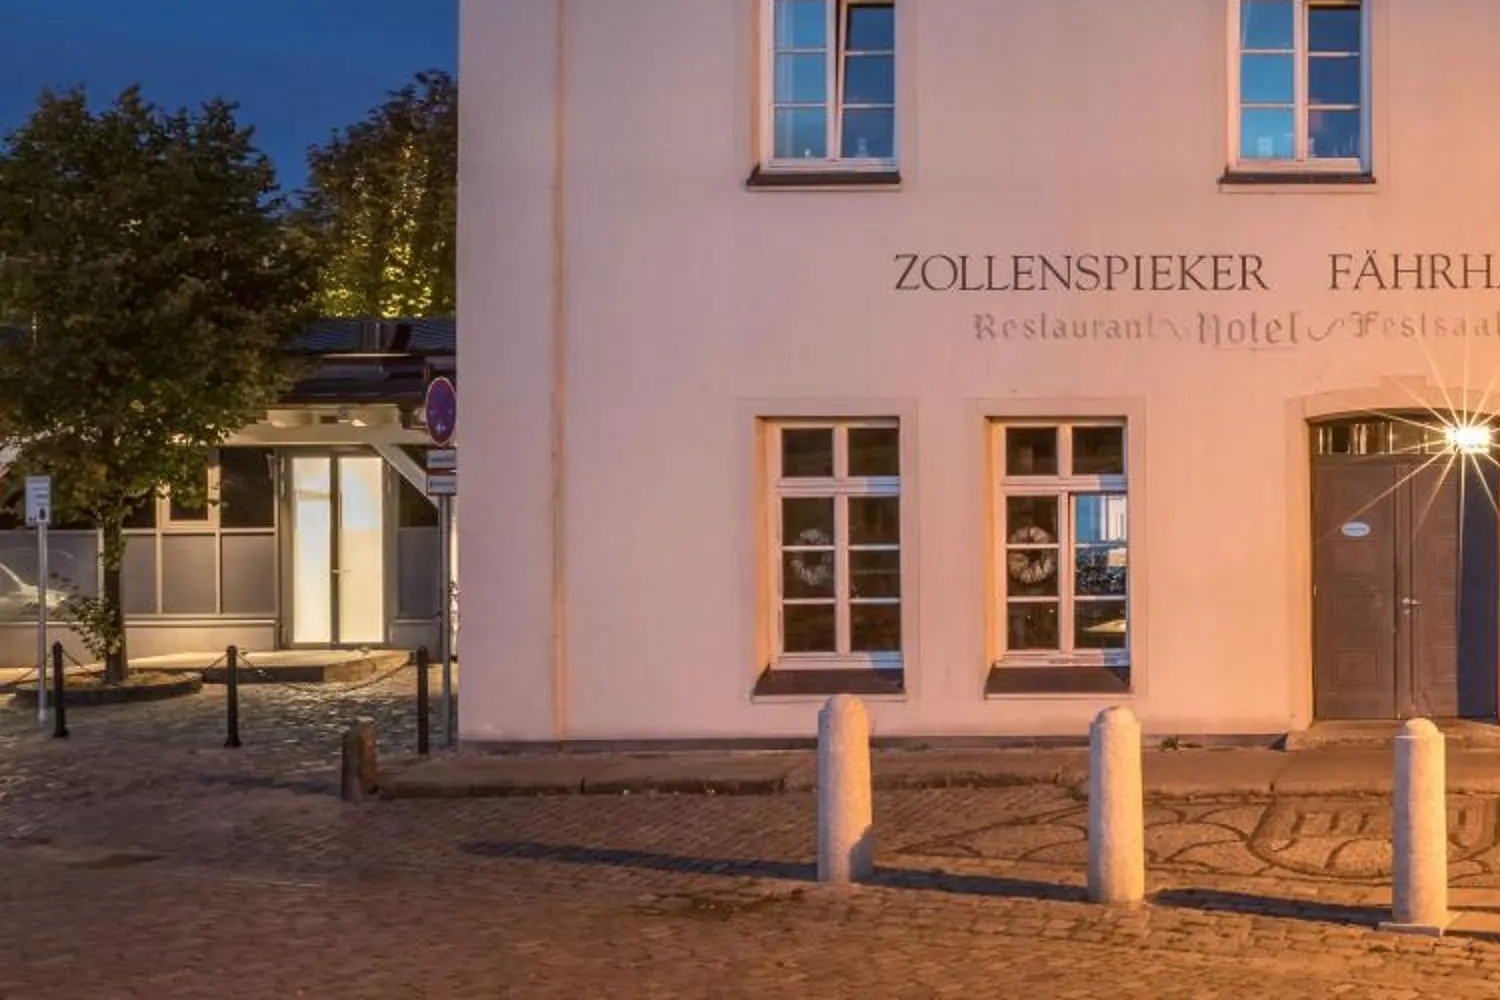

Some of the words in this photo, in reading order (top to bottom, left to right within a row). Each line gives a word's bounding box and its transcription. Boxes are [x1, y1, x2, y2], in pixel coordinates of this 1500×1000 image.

[895, 253, 1268, 292] ZOLLENSPIEKER
[973, 311, 1153, 341] Restaurant
[1196, 309, 1302, 346] Hotel
